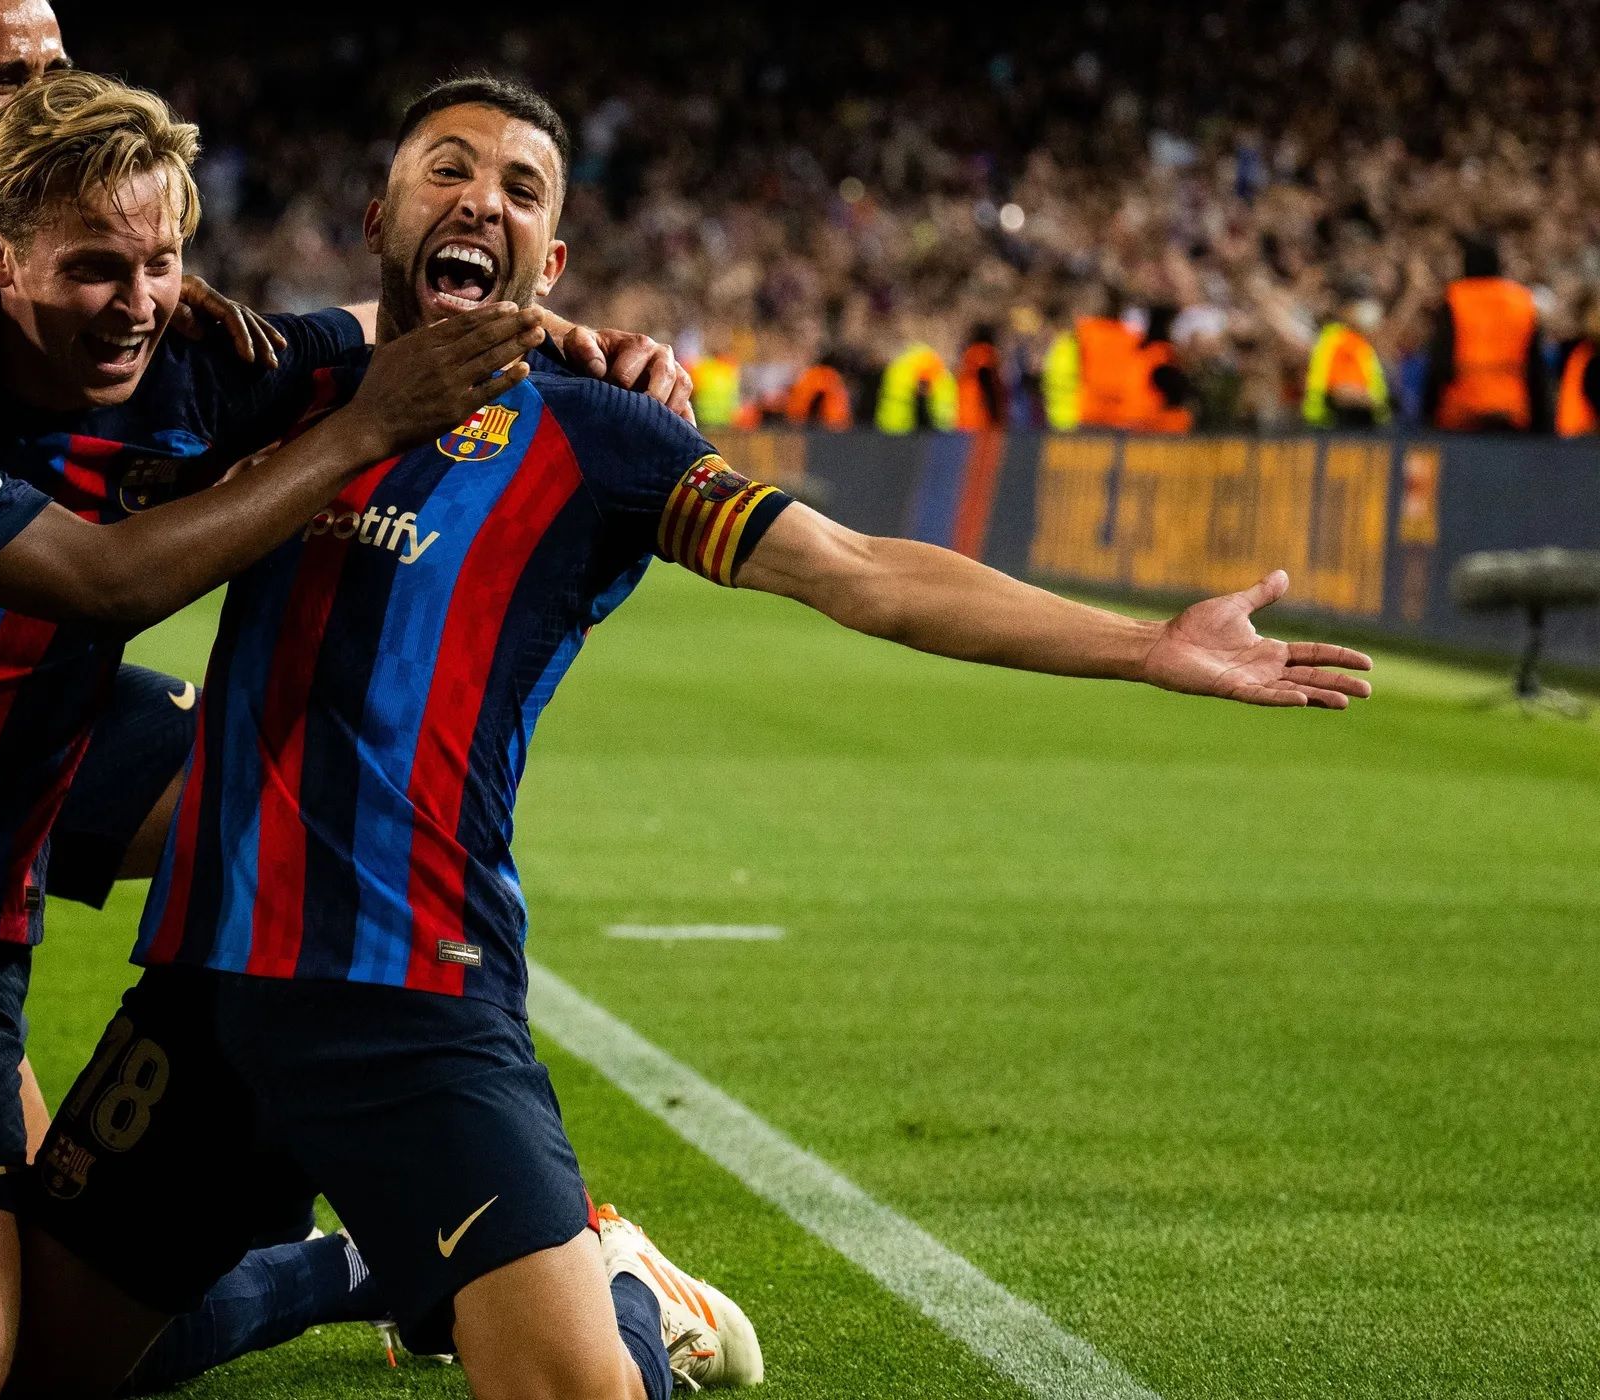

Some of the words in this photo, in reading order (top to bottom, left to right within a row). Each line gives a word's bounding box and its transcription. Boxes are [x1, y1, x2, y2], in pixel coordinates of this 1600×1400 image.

[461, 427, 489, 440] FCB
[301, 505, 441, 565] potify
[65, 1015, 170, 1153] 18
